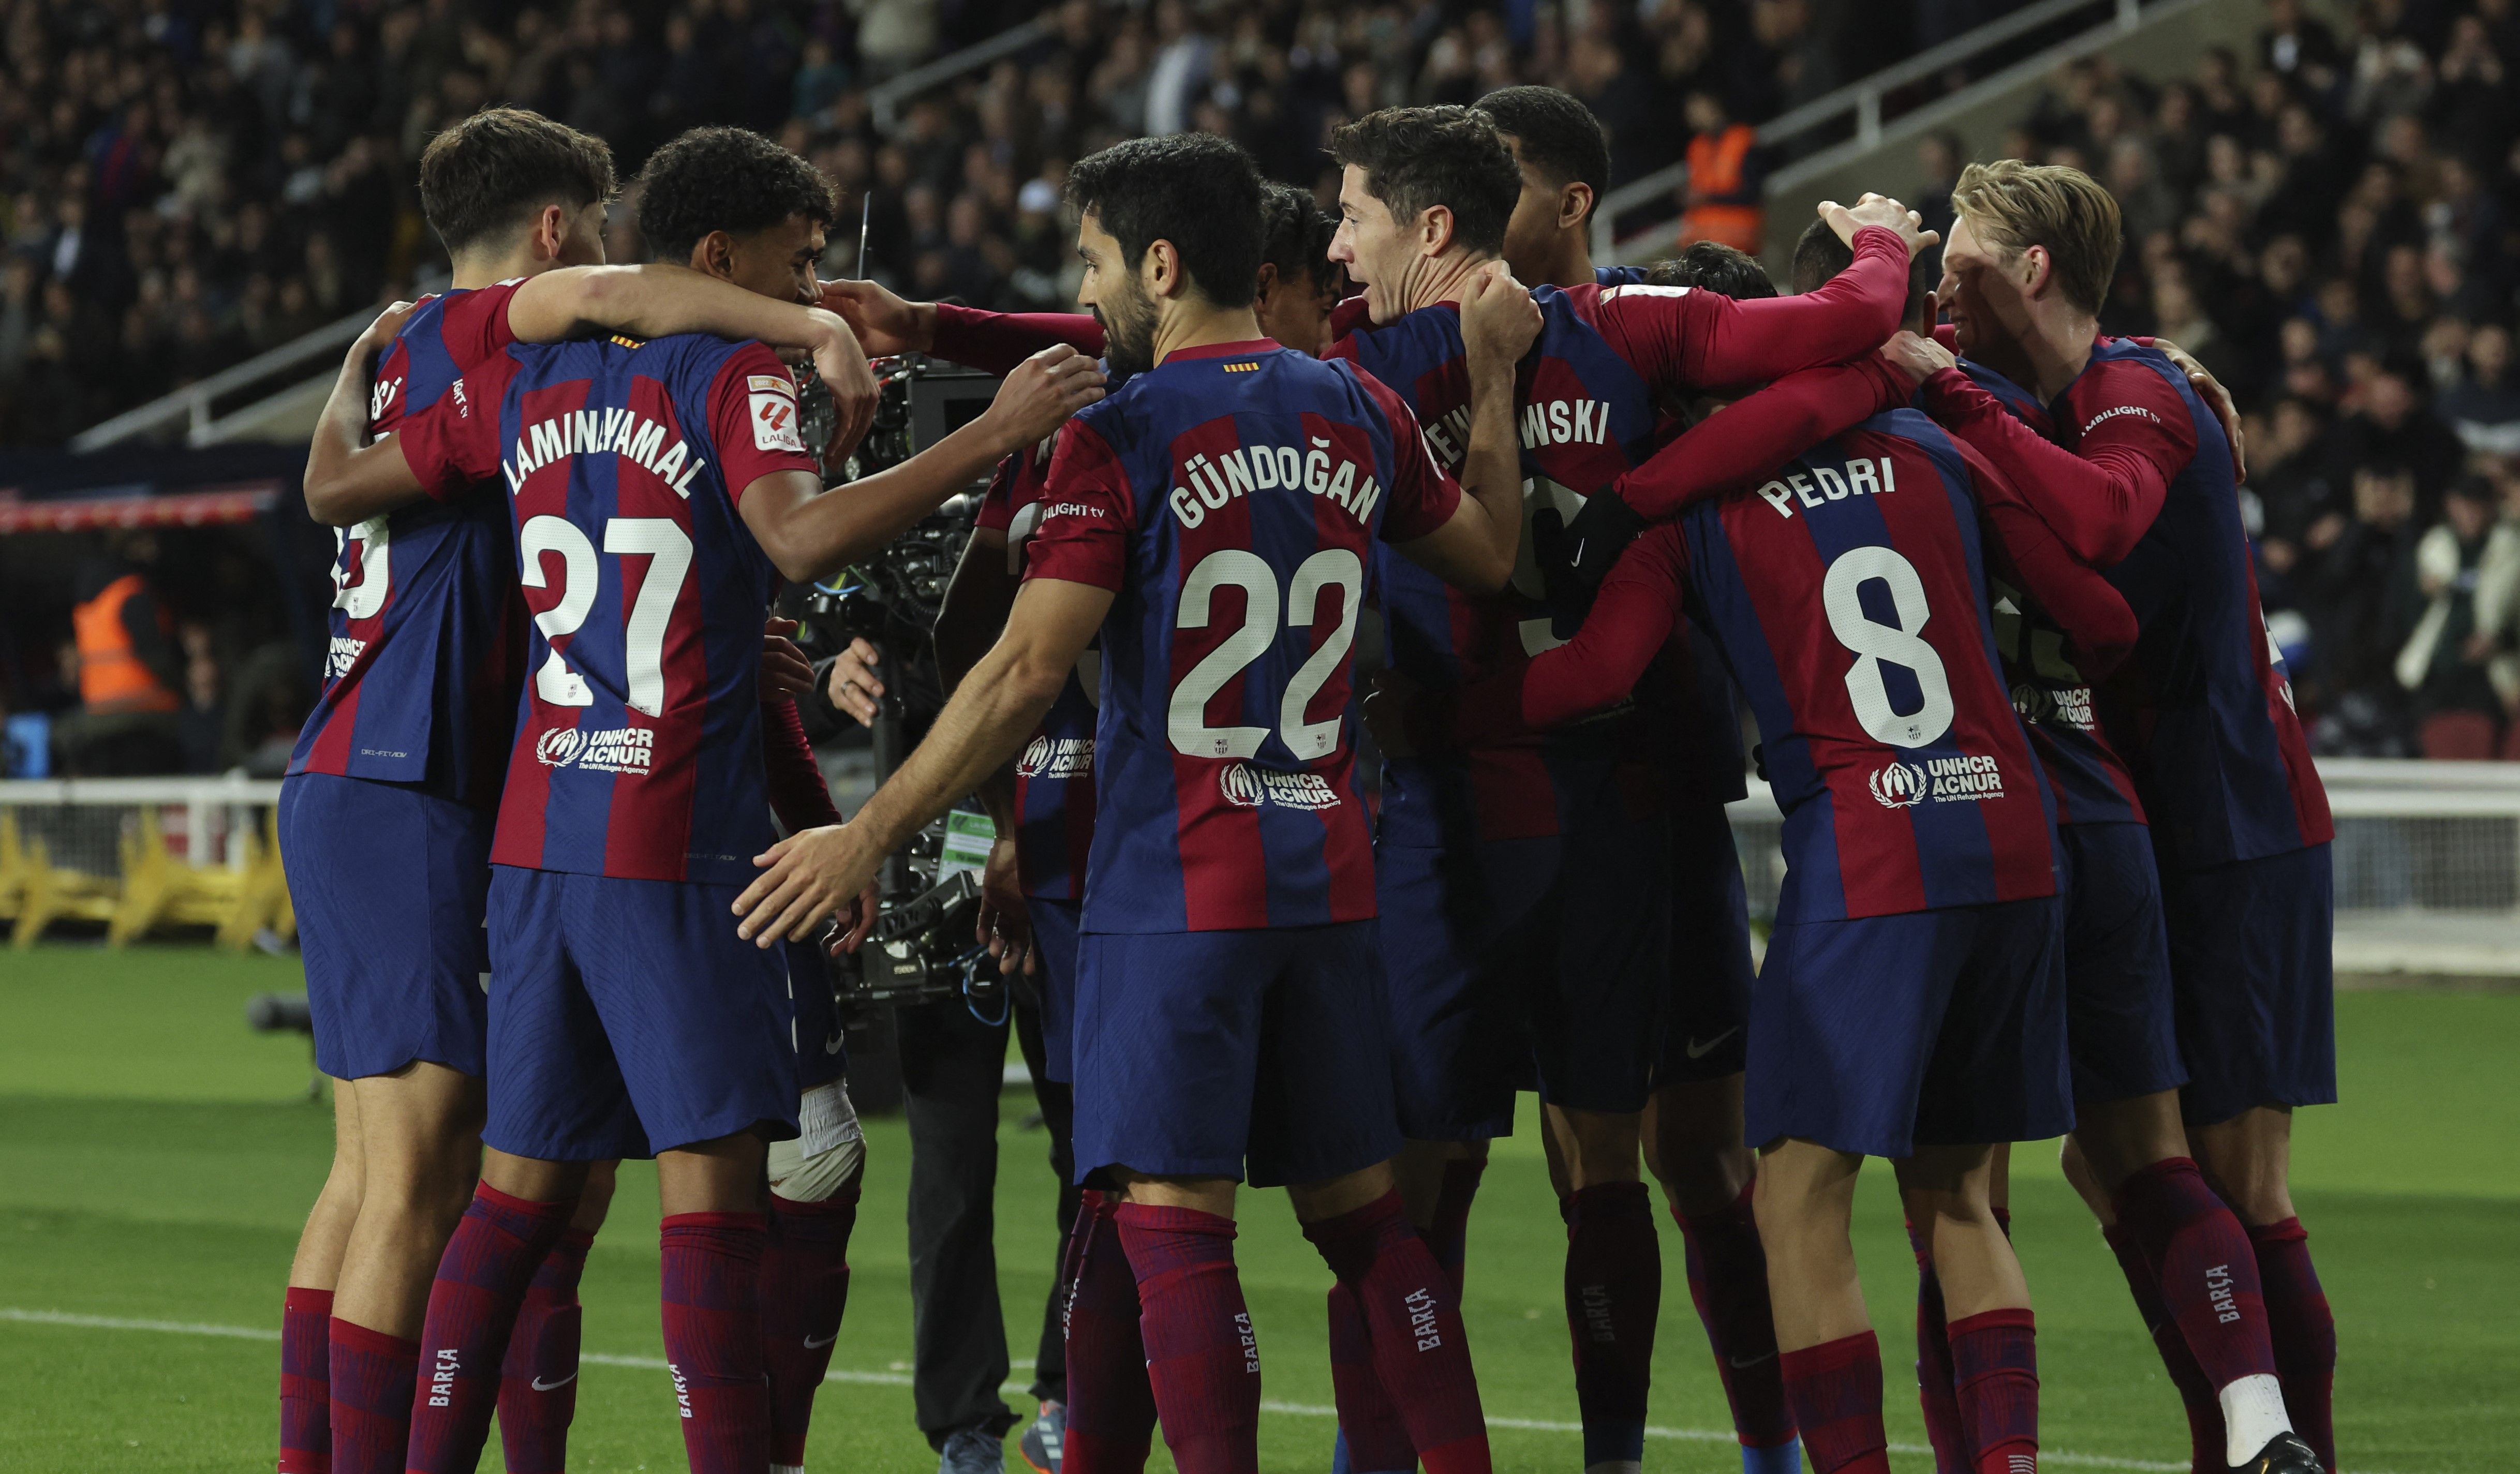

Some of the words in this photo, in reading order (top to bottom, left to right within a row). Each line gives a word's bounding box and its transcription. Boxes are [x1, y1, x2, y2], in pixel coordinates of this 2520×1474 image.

[452, 378, 467, 405] IGHT
[2151, 412, 2161, 424] tv
[762, 434, 797, 448] LALIGA
[1169, 435, 1381, 529] GÜNDOĞAN
[1757, 457, 1895, 518] PEDRI
[1090, 507, 1105, 518] tv
[521, 515, 694, 719] 27
[1167, 548, 1363, 761] 22
[1823, 545, 1954, 749] 8
[590, 728, 654, 748] UNHCR
[580, 746, 651, 767] ACNUR
[1048, 754, 1093, 772] ACNUR
[1927, 755, 1998, 777] UNHCR
[598, 765, 622, 773] Refugee
[622, 766, 649, 776] Agency
[1262, 769, 1329, 790] UNHCR
[1932, 772, 2003, 795] ACNUR
[1268, 787, 1338, 803] ACNUR
[1294, 803, 1317, 811] Refugee
[1317, 799, 1341, 809] Agency
[2206, 1264, 2241, 1324] BARÇA
[1404, 1287, 1441, 1352] BARÇA
[428, 1349, 461, 1407] BARÇA
[668, 1364, 693, 1418] BARÇA
